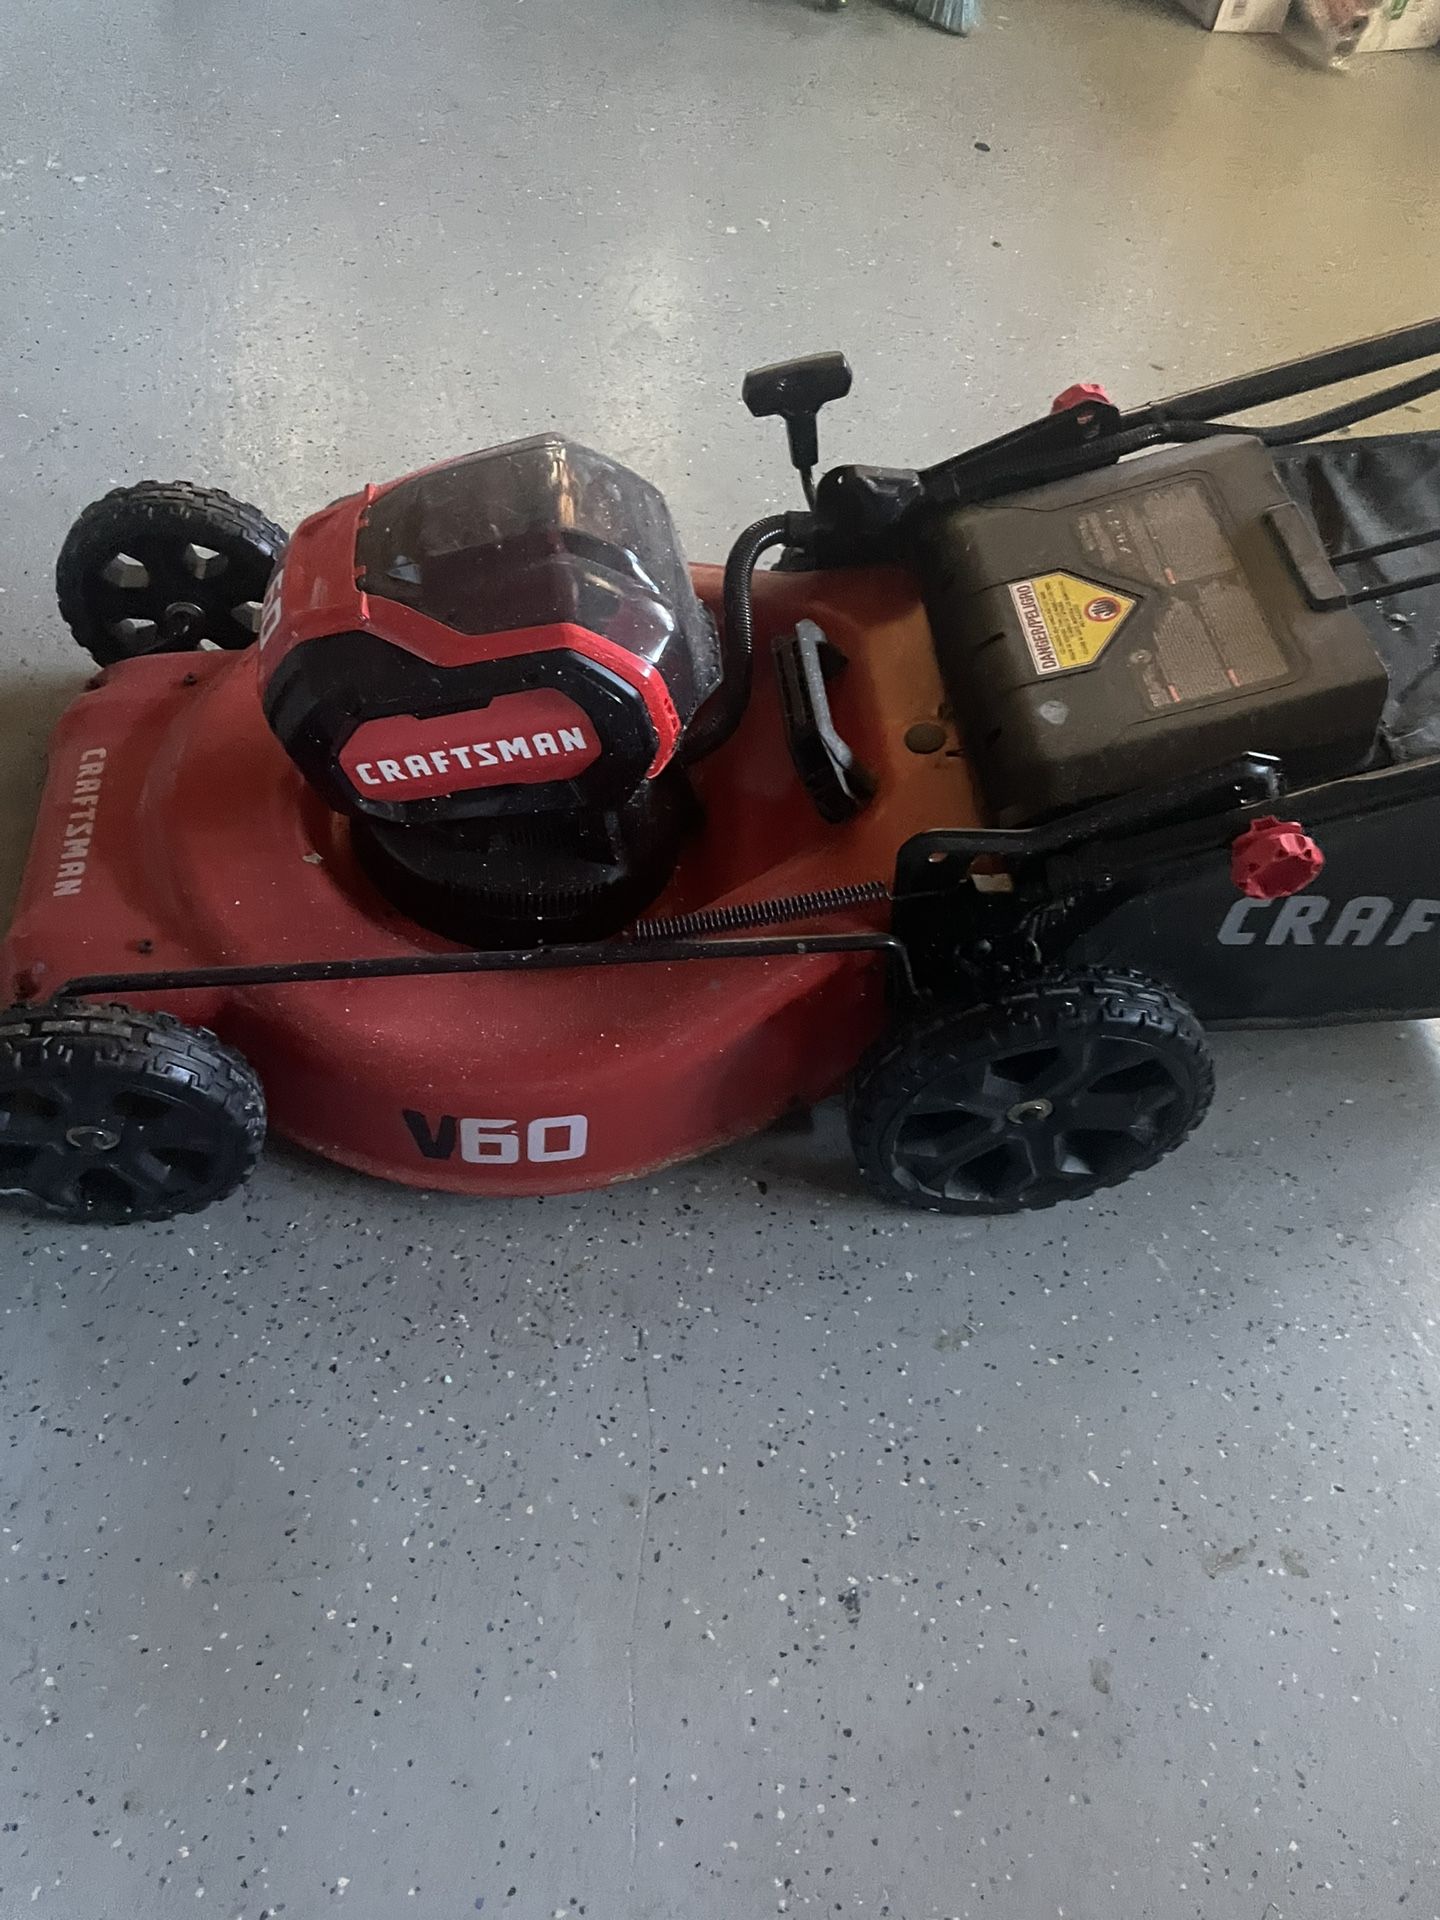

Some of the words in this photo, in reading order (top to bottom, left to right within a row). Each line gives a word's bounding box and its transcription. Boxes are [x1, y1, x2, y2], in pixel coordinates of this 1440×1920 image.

[1016, 584, 1057, 669] DANGER/PELIGRO
[355, 726, 588, 785] CRAFTSMAN
[53, 747, 107, 897] CRAFTSMAN
[1217, 895, 1440, 946] CRAF
[402, 1109, 588, 1164] V60
